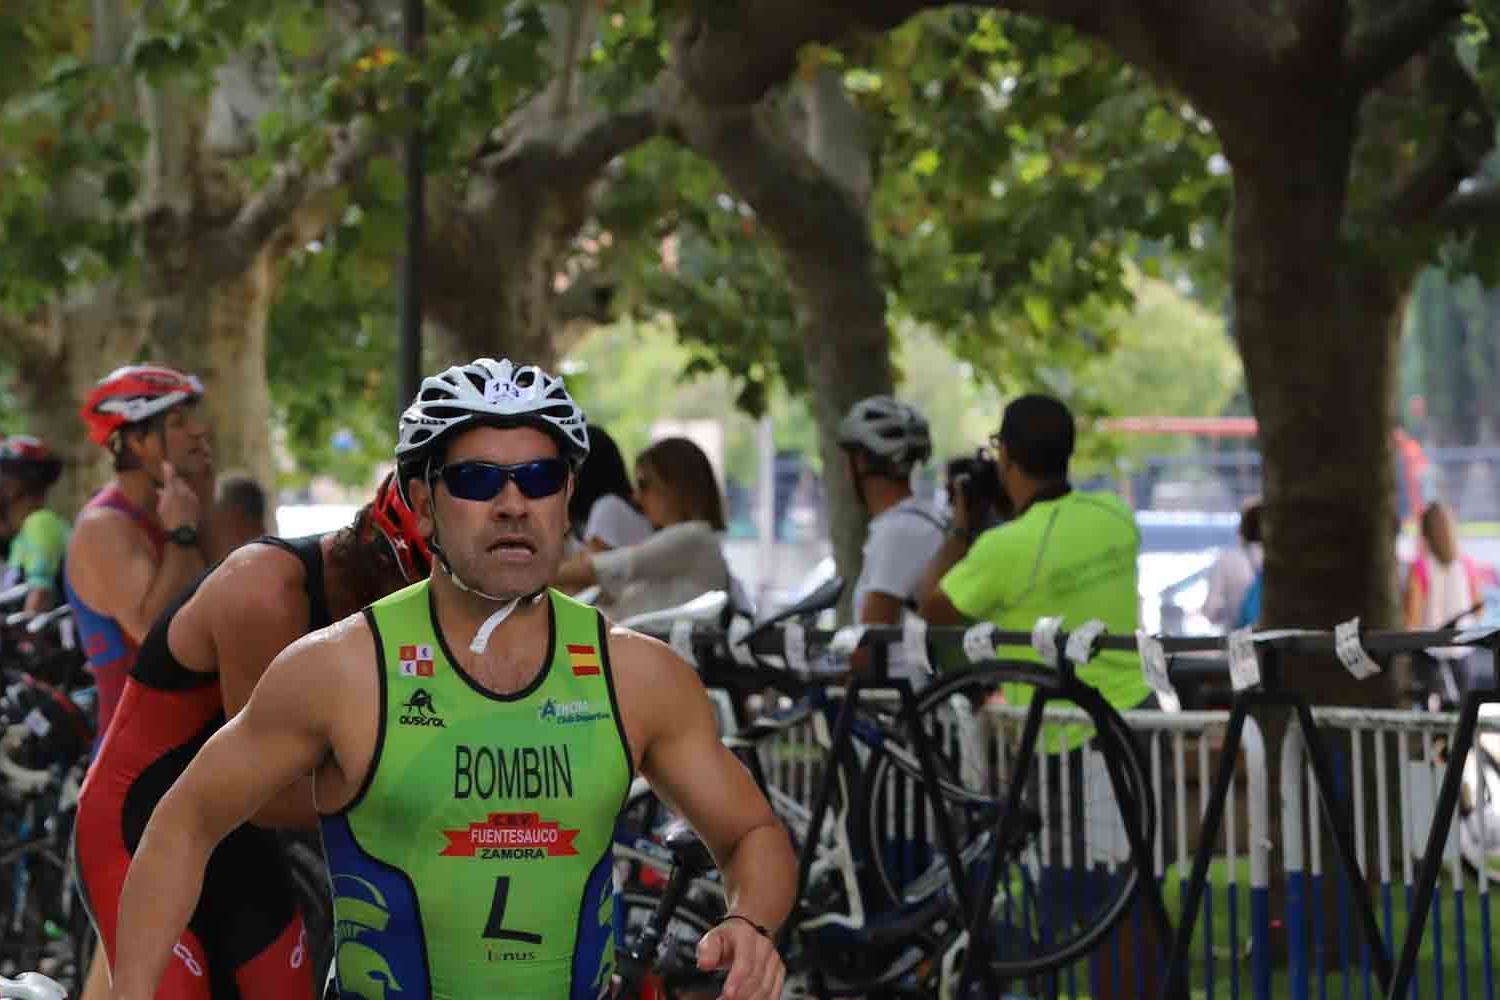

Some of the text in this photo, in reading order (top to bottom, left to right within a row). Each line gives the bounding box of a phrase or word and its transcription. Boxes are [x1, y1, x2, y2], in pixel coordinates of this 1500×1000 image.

[454, 744, 573, 799] BOMBIN
[470, 828, 558, 843] FUENTESAUCO
[480, 848, 545, 860] ZAMORA
